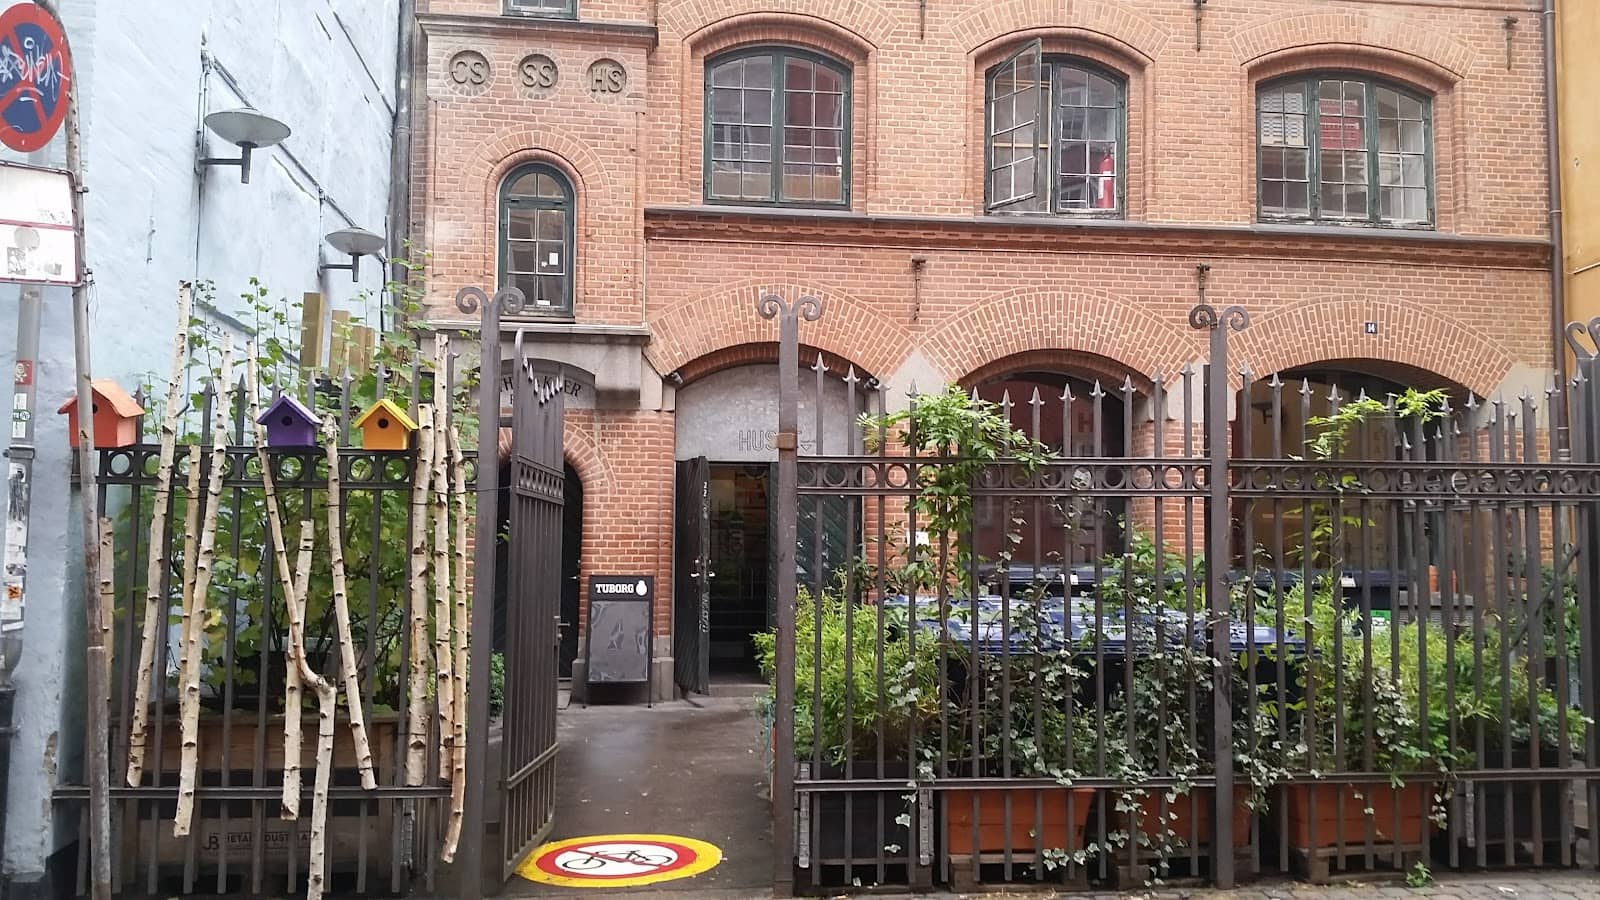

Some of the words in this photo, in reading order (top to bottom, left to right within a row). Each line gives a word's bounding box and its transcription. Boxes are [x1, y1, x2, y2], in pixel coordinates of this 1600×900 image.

[451, 60, 485, 85] CS
[522, 63, 554, 88] SS
[591, 67, 623, 93] HS
[595, 583, 635, 594] TUBORG
